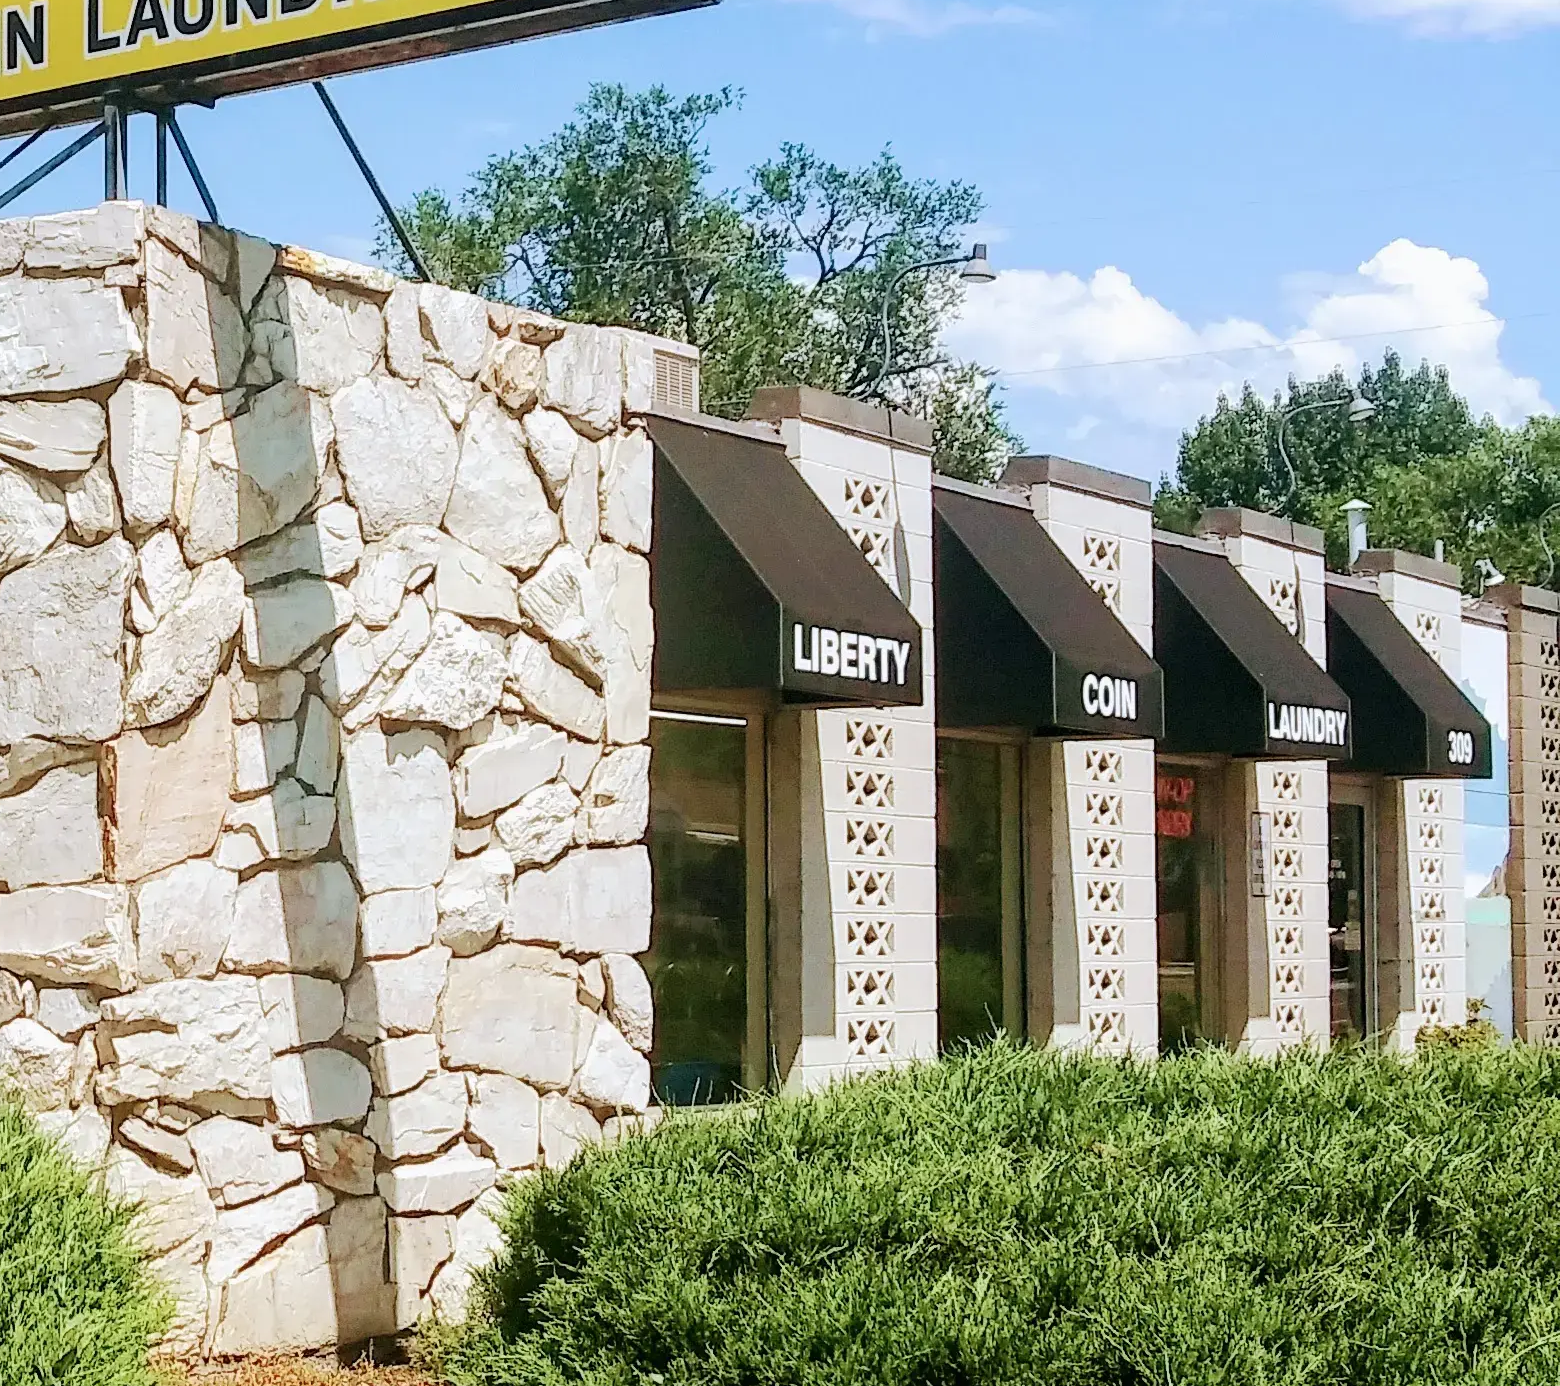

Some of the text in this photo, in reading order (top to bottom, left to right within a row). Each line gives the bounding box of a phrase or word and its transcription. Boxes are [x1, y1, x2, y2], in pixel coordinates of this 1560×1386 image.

[793, 623, 911, 685] LIBERTY
[1082, 673, 1137, 720] COIN
[1268, 702, 1347, 746] LAUNDRY
[1448, 730, 1473, 764] 309
